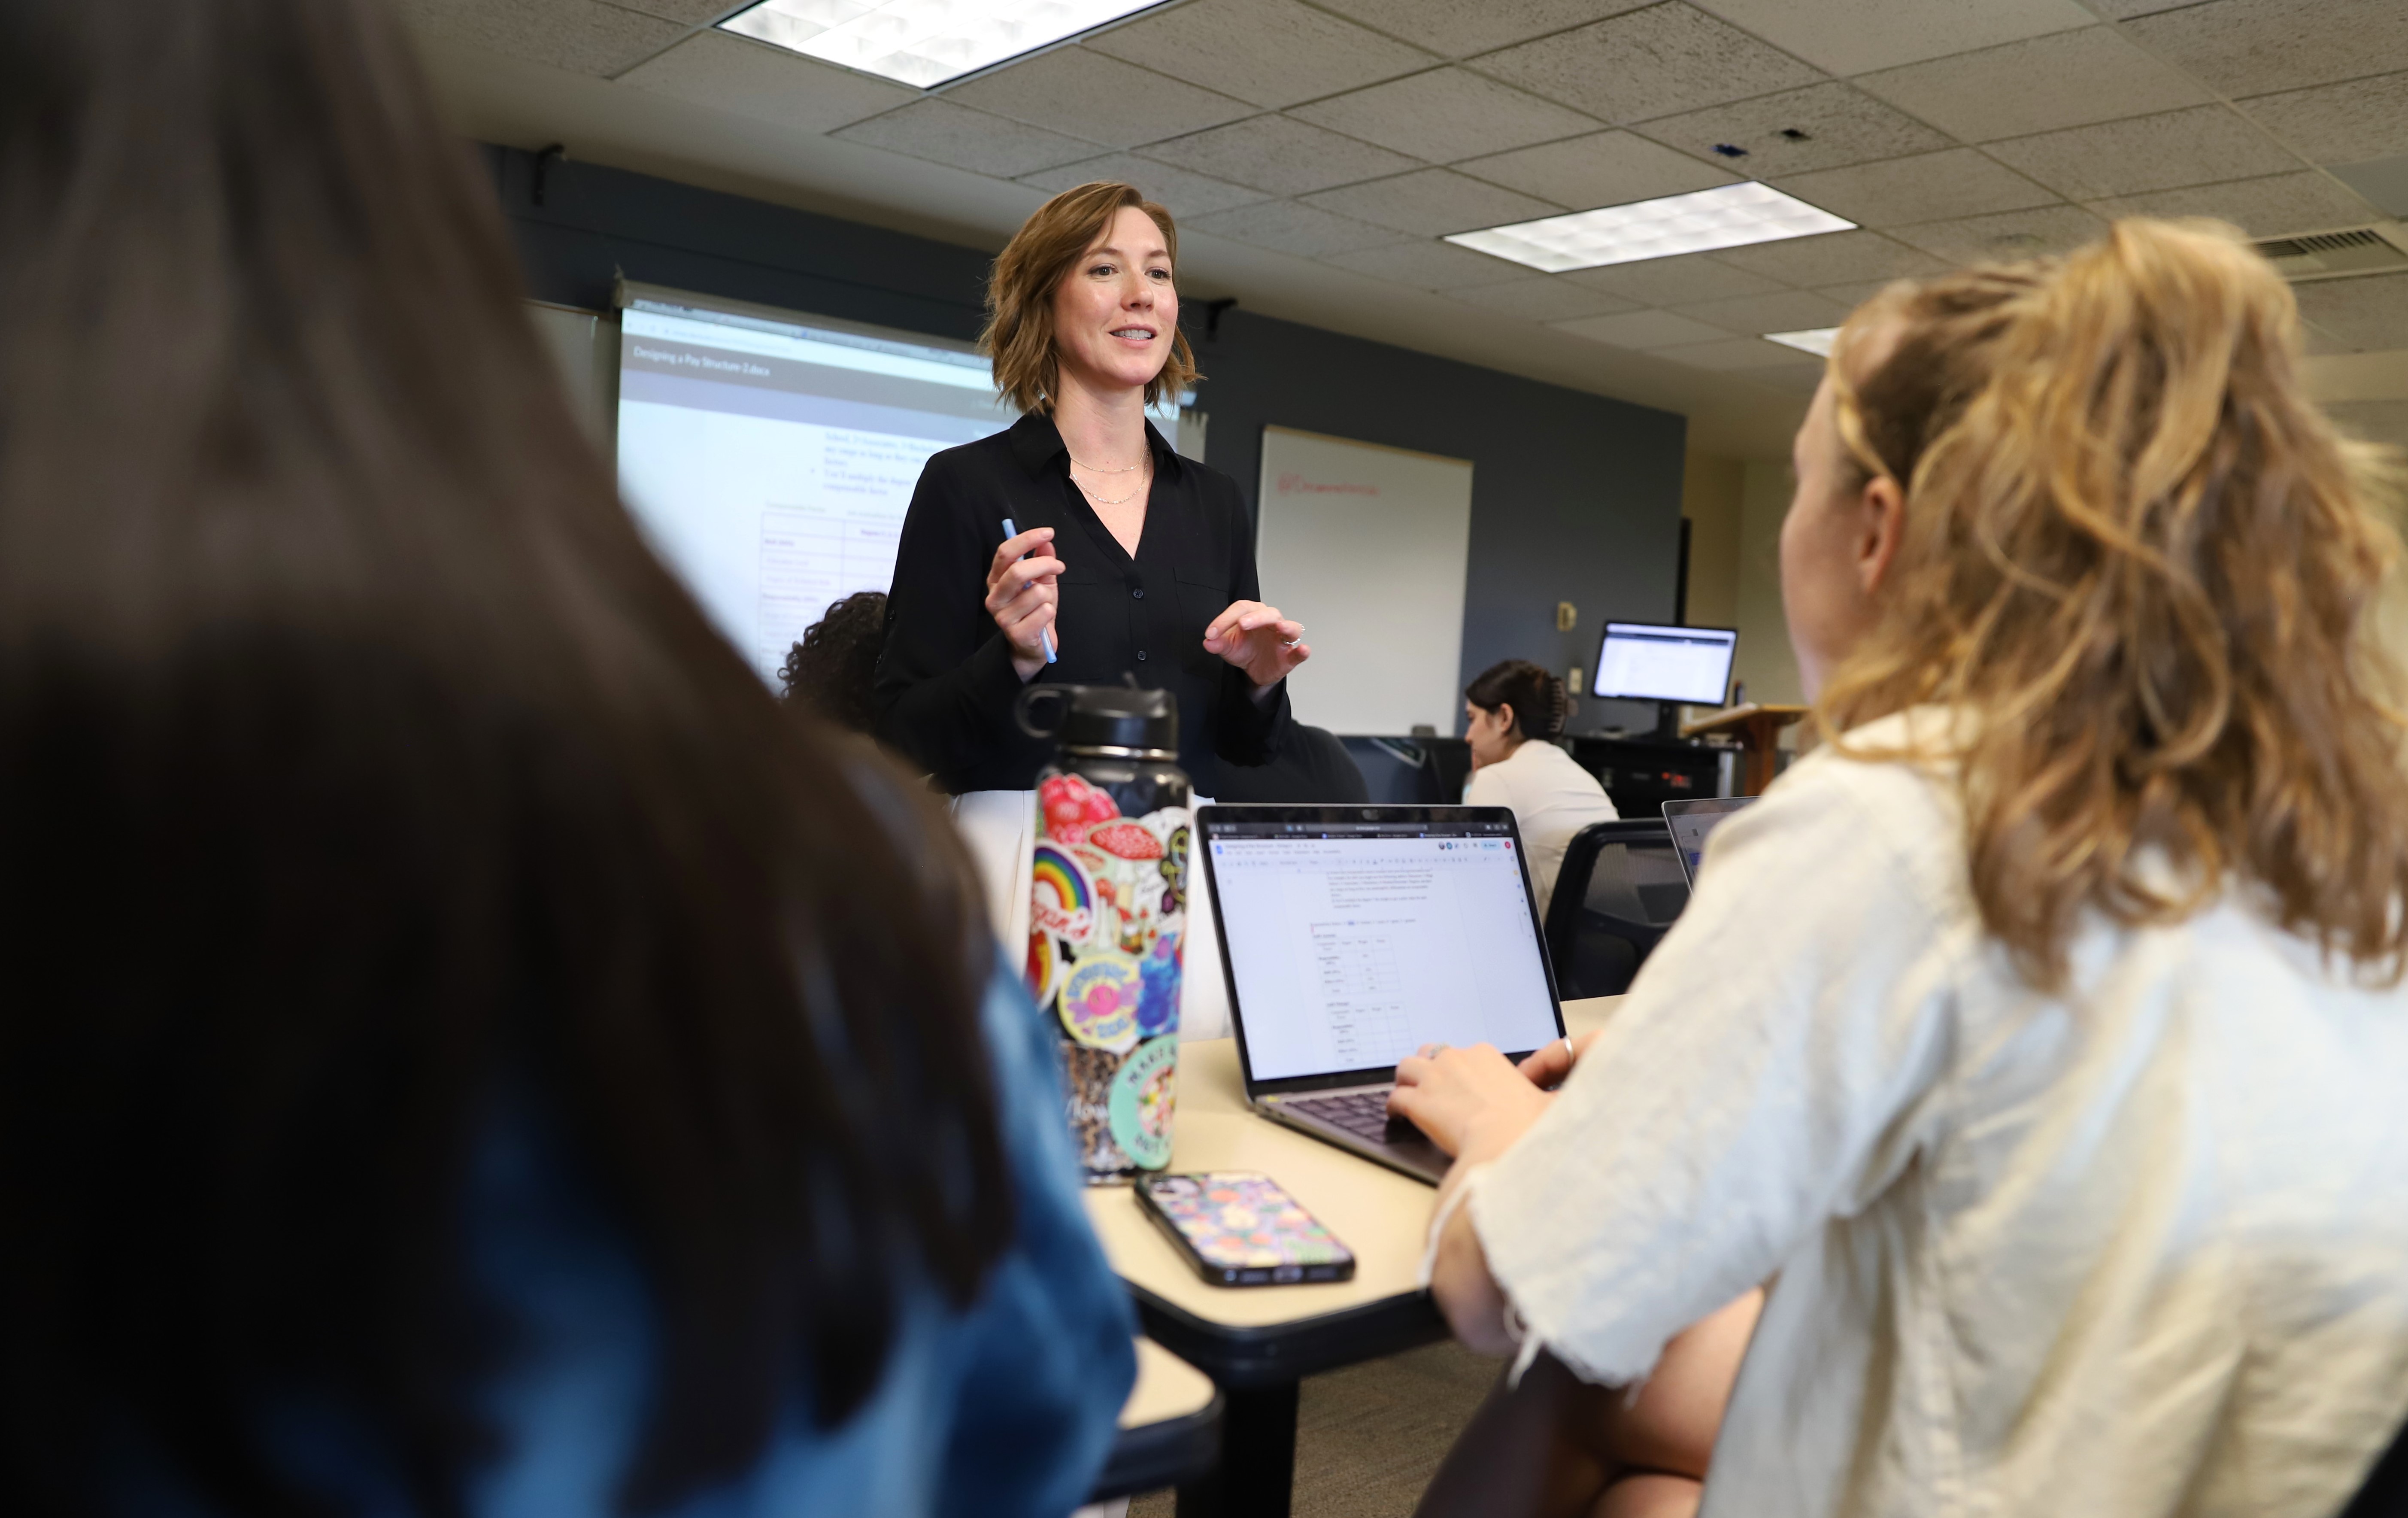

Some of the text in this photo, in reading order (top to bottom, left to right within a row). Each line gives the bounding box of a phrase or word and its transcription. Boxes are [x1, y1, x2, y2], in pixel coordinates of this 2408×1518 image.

[633, 346, 676, 364] Designing
[678, 355, 683, 364] a
[684, 353, 700, 367] Pay
[702, 356, 740, 371] Structure
